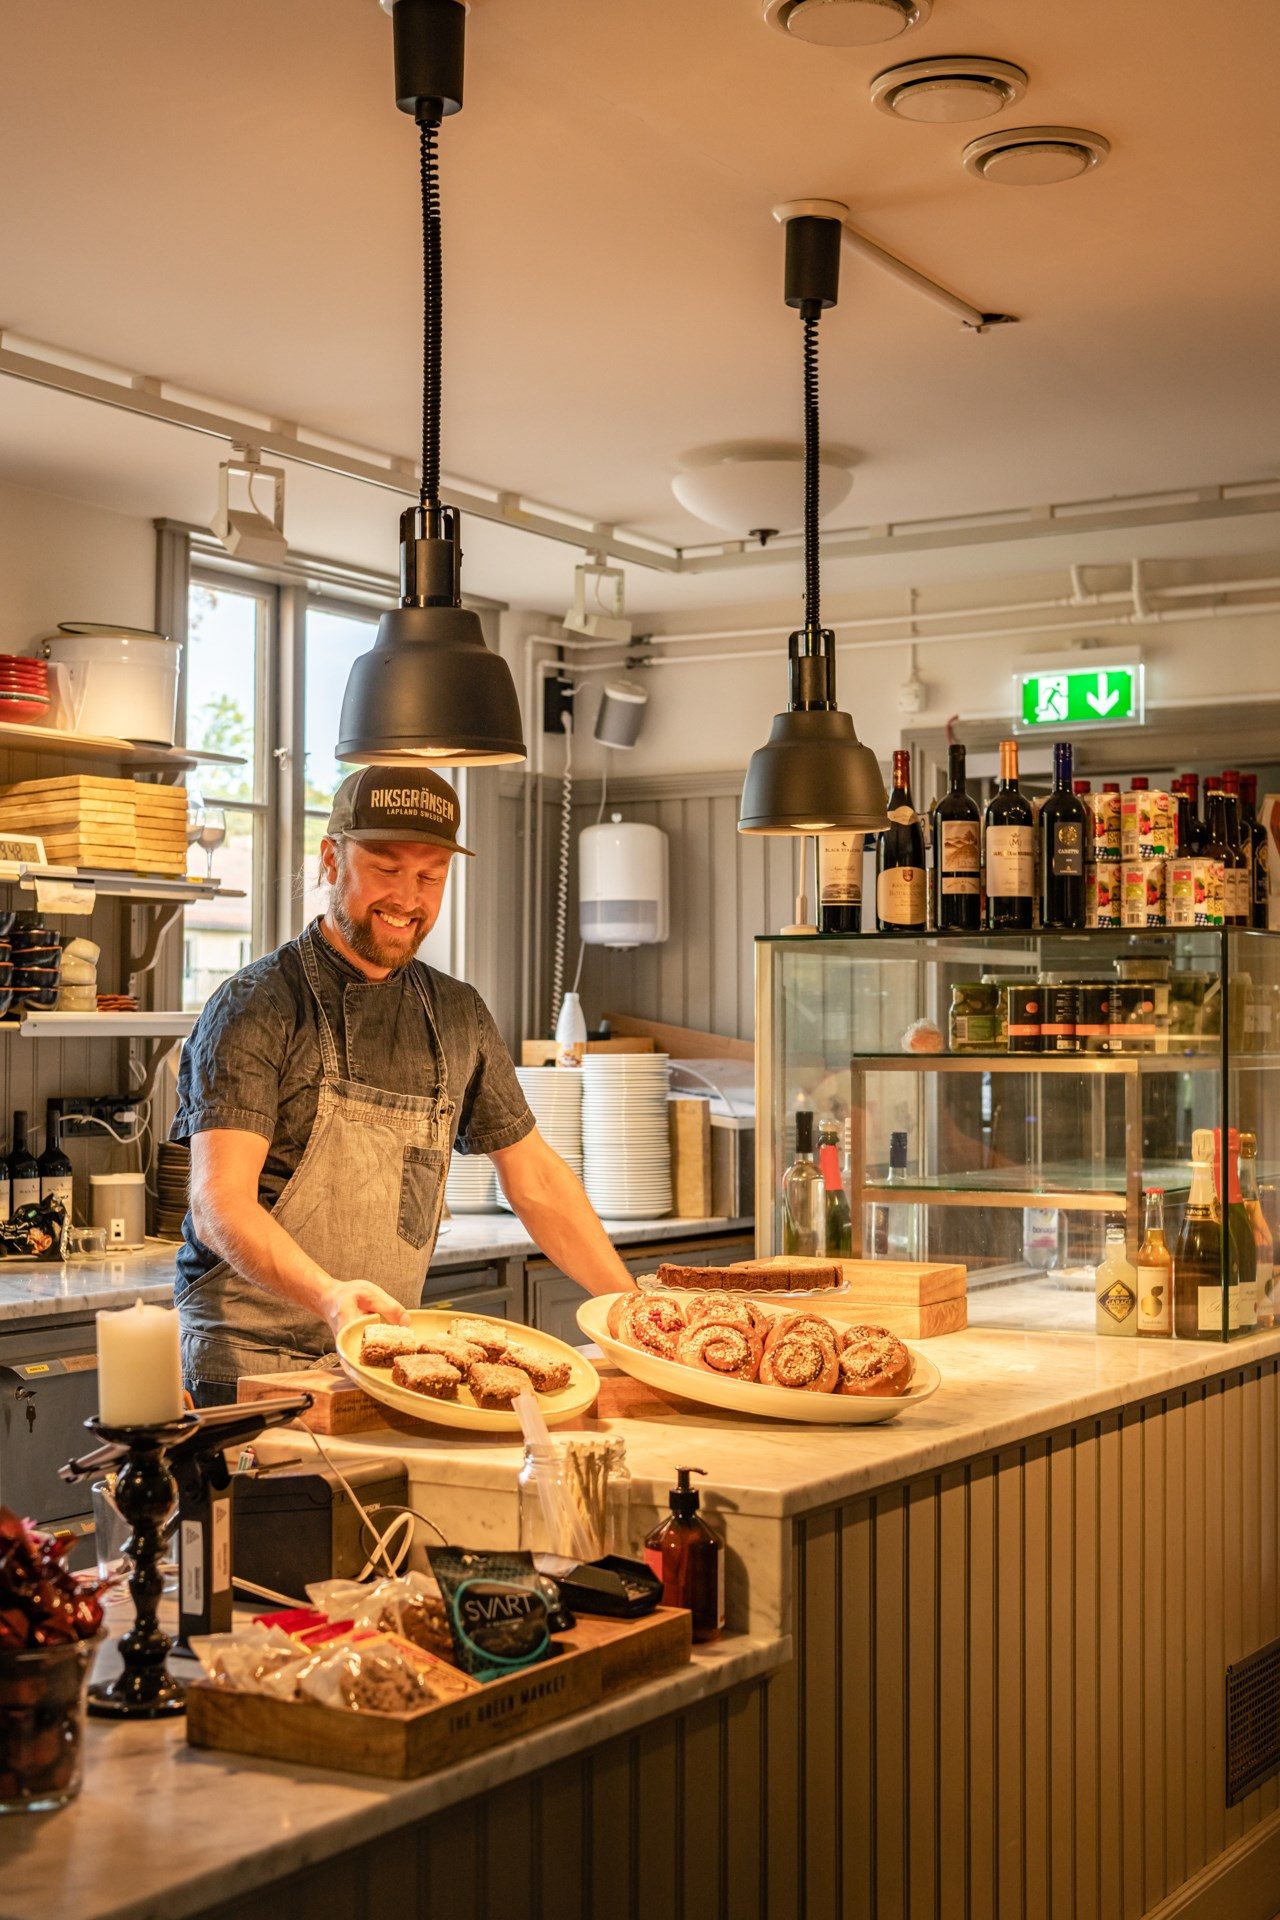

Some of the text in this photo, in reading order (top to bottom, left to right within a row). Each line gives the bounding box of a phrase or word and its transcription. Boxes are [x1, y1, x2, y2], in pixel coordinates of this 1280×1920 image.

[371, 787, 454, 822] RIKSGRÄNSEN
[387, 808, 443, 823] LAPLAND SWEDEN
[464, 1592, 531, 1621] SVART
